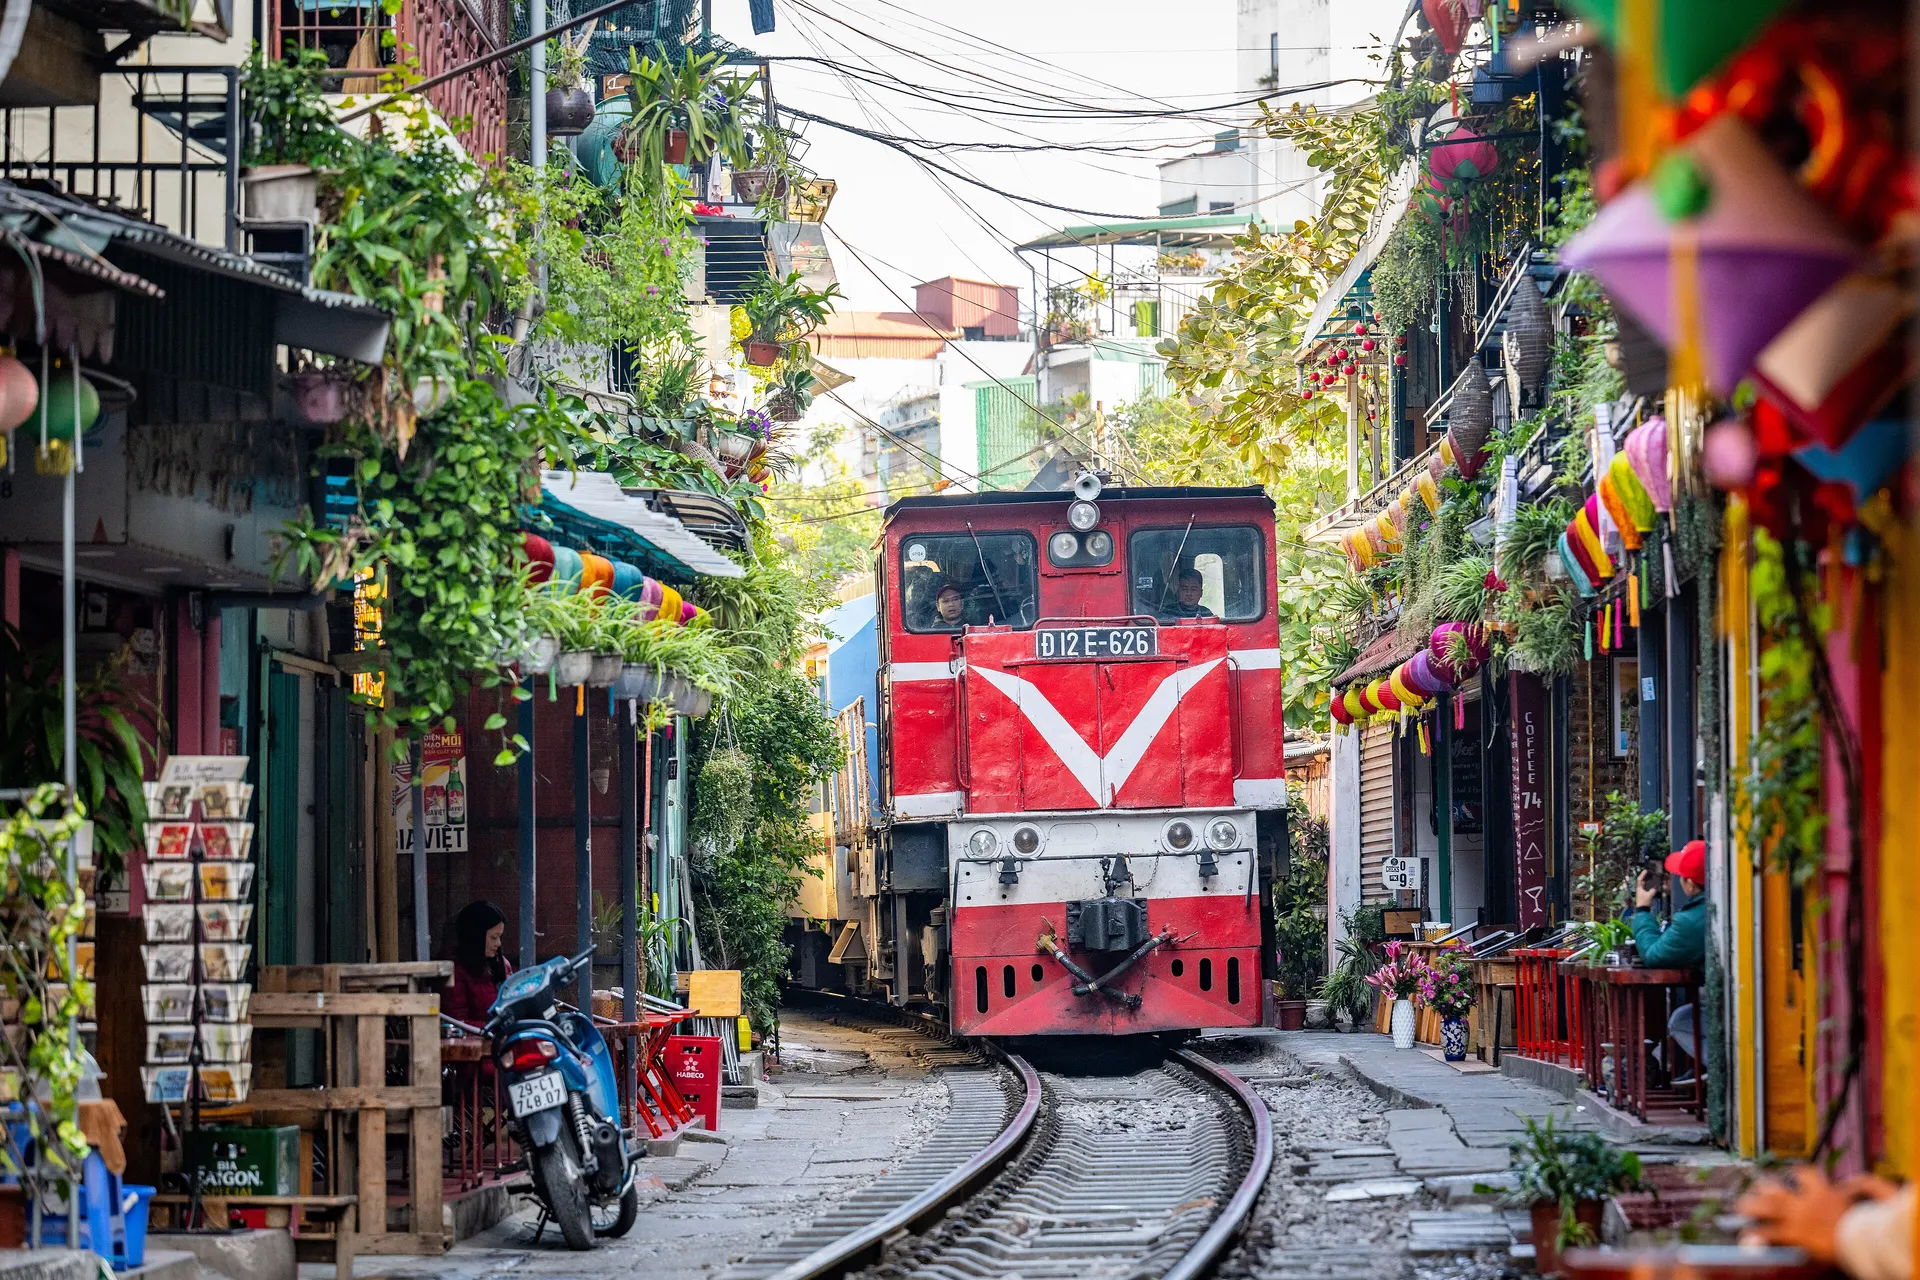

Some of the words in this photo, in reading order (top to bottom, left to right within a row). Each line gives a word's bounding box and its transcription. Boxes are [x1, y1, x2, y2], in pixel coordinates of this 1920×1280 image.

[1525, 712, 1536, 784] COFFEE
[1521, 791, 1542, 809] 74
[396, 829, 415, 849] IA
[424, 825, 465, 851] VIỆT
[676, 1071, 704, 1079] HABECO
[517, 1077, 554, 1099] 29-C1
[516, 1089, 560, 1113] 748.07
[216, 1160, 238, 1171] BIA
